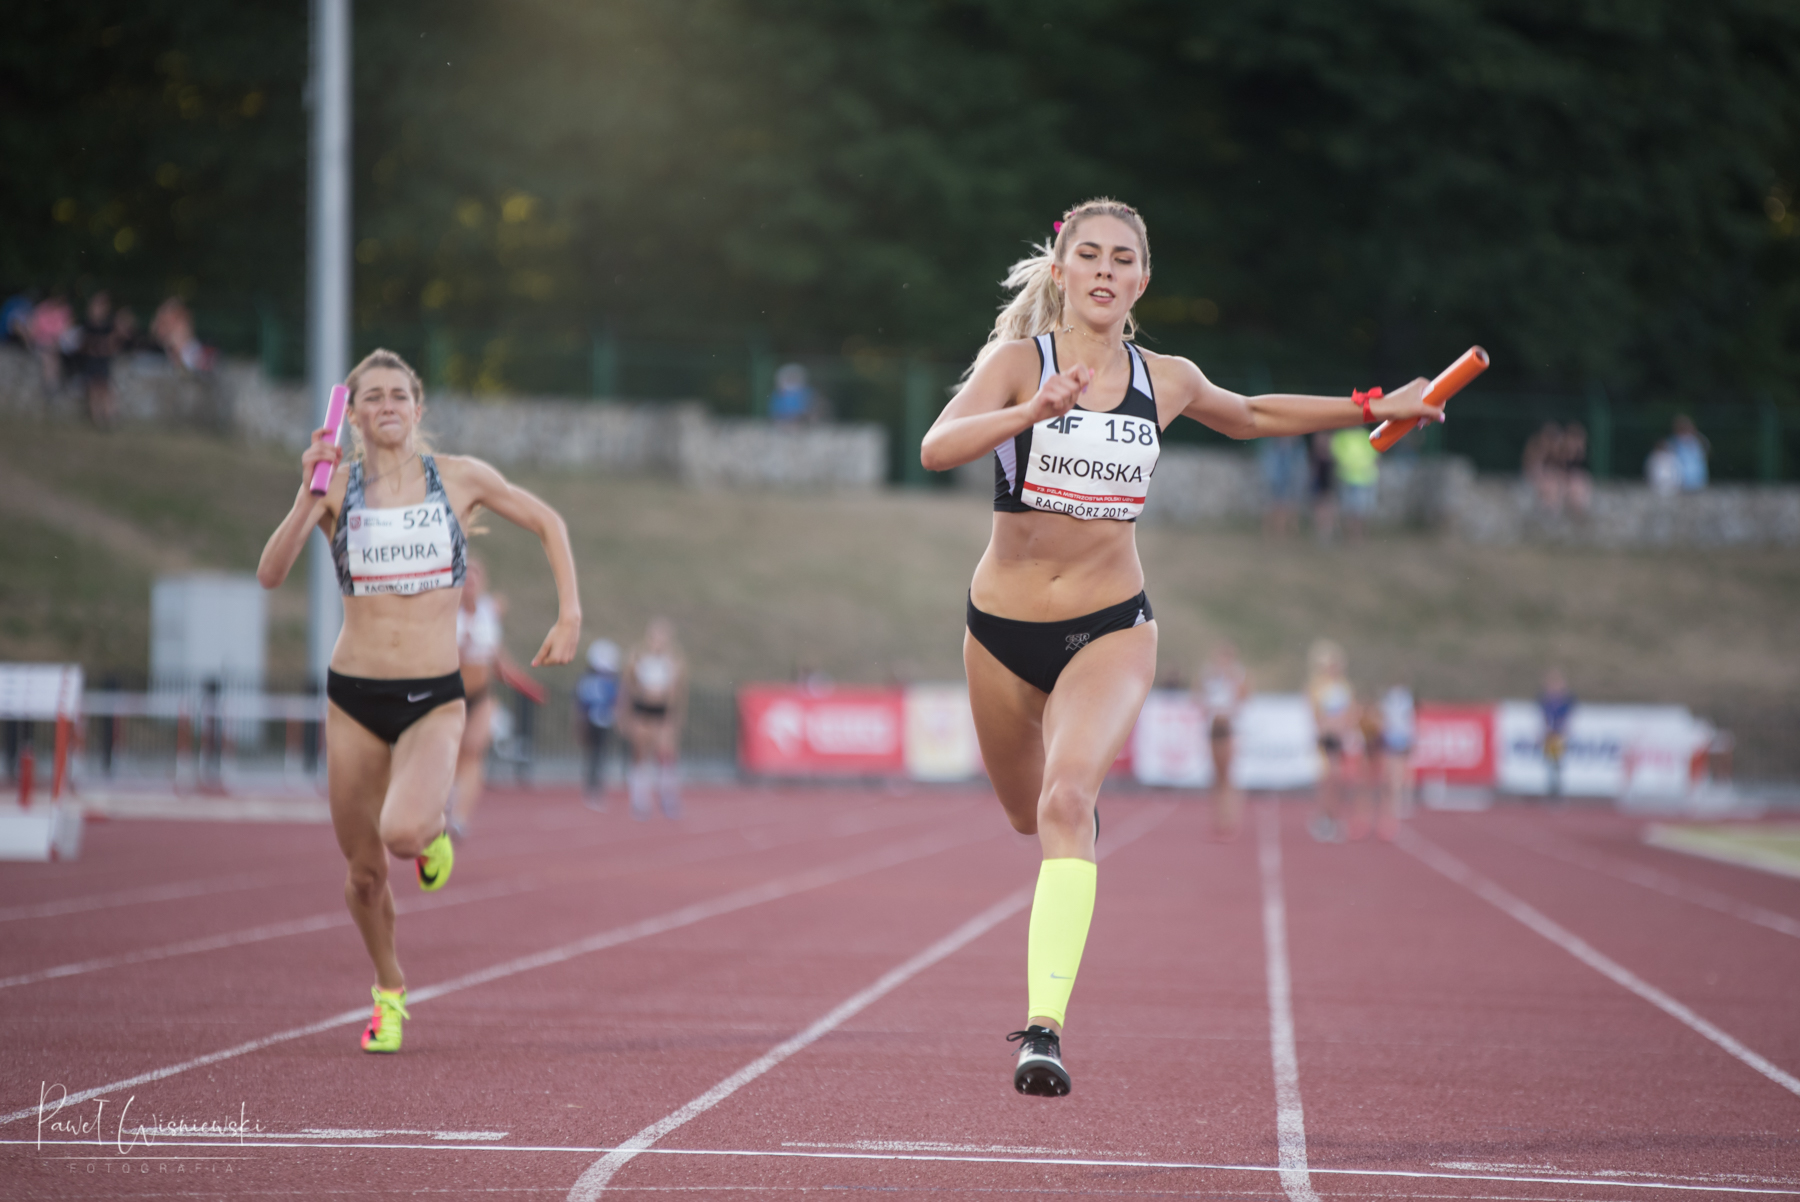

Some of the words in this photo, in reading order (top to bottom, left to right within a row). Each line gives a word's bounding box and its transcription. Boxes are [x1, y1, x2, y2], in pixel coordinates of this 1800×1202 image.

[1105, 419, 1153, 446] 158
[1038, 454, 1142, 483] SIKORSKA
[403, 507, 442, 530] 524
[1035, 496, 1099, 517] RACIBÓRZ
[1103, 507, 1128, 518] 2019
[362, 543, 438, 564] KIEPURA
